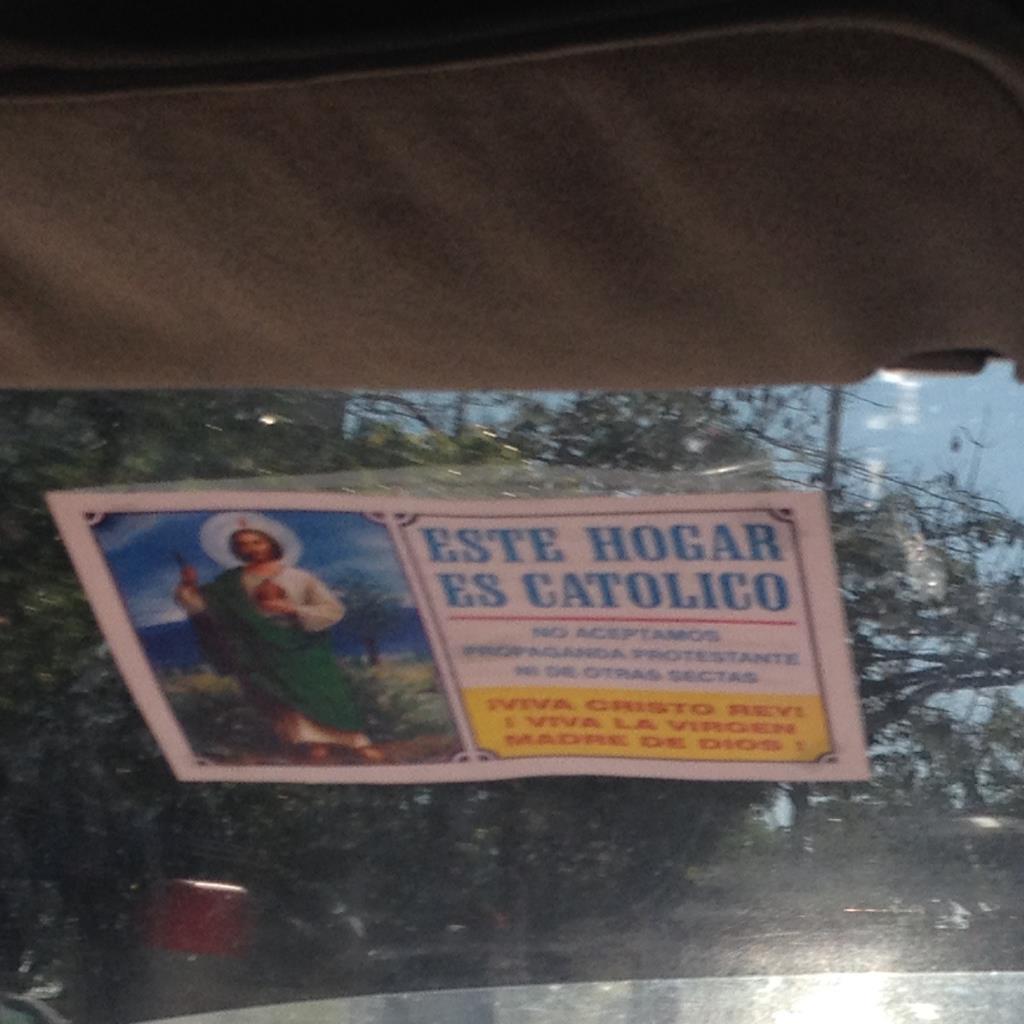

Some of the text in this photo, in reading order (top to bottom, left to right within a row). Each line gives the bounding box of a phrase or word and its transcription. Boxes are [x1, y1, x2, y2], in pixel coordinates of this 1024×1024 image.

[420, 522, 783, 563] ESTE HOGAR
[437, 571, 791, 612] ES CATOLICO
[532, 627, 720, 642] NO ACEPTAMOS
[463, 643, 800, 666] PROPAGANDA PROTESTANTE
[583, 667, 662, 682] OTRAS
[668, 669, 759, 684] SECTAS
[585, 699, 716, 716] CRISTO
[526, 715, 602, 729] VIVA
[614, 718, 658, 730] LA
[667, 719, 796, 735] VIRGEN
[505, 734, 628, 747] MADRE
[638, 735, 687, 750] DE
[698, 737, 784, 752] DIOS
